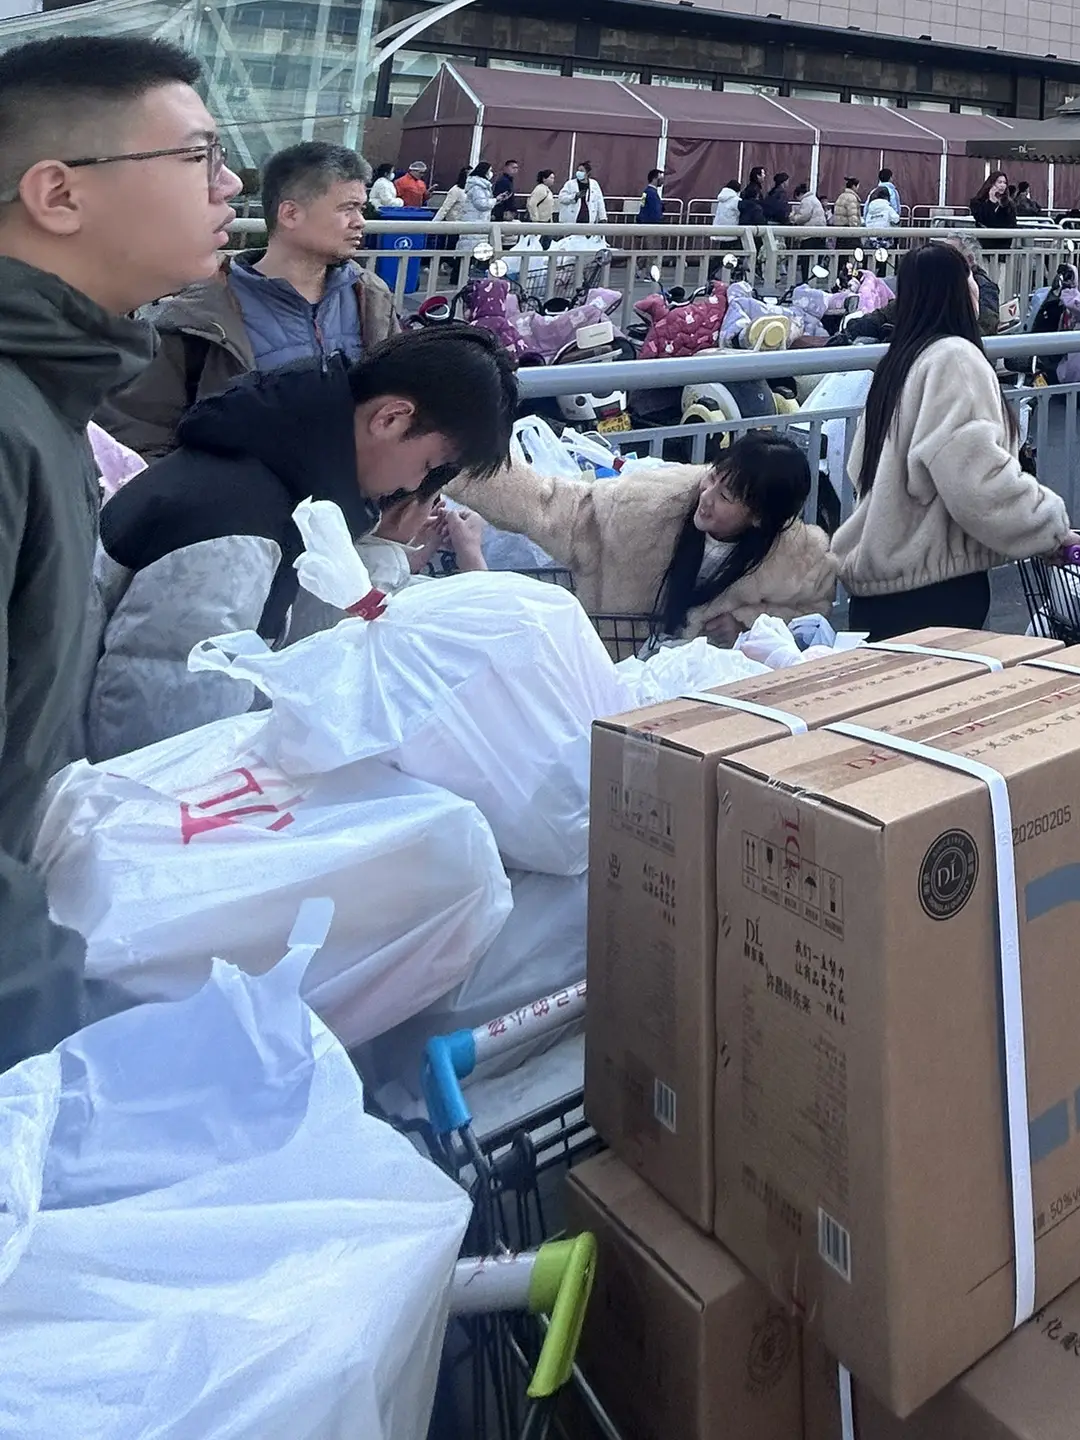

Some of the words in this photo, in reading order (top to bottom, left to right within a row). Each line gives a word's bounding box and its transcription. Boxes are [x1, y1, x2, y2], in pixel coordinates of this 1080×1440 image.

[1012, 805, 1072, 847] 20260205
[795, 939, 846, 983] 我们一直努力
[795, 961, 847, 1006] 让商品更实在
